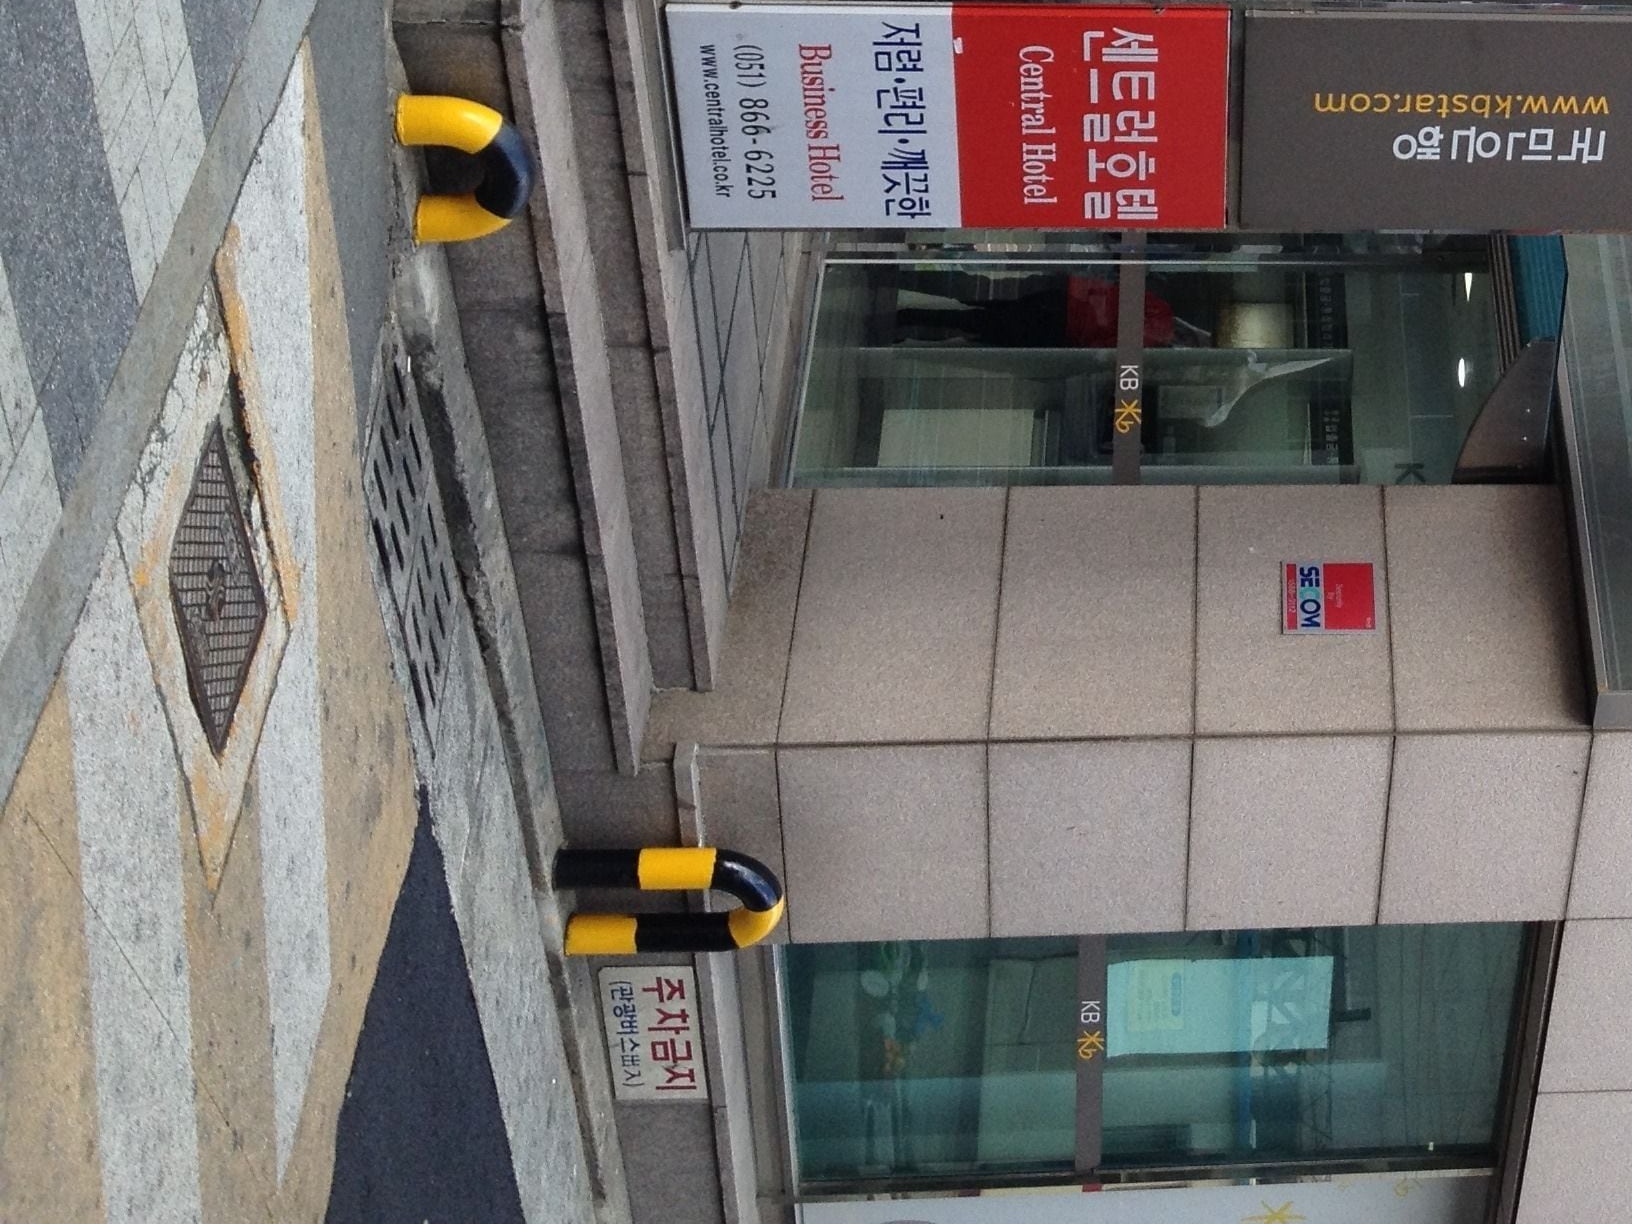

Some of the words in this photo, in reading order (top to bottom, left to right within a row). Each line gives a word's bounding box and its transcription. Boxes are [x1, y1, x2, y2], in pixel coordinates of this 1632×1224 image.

[731, 45, 767, 89] (051)
[797, 43, 835, 139] Business
[1018, 45, 1057, 134] Central
[698, 44, 733, 198] www.centralhotel.co.kr
[1081, 27, 1159, 220] 센트럴호텔
[1313, 92, 1610, 119] www.kbstar.com
[737, 97, 778, 199] 866-6225
[807, 144, 844, 202] Hotel
[1021, 142, 1058, 205] Hotel
[1392, 125, 1607, 165] 국민은행
[1119, 364, 1140, 391] KB
[1299, 566, 1321, 628] SECOM
[642, 977, 698, 1090] 주차금지
[1080, 1000, 1101, 1024] KB
